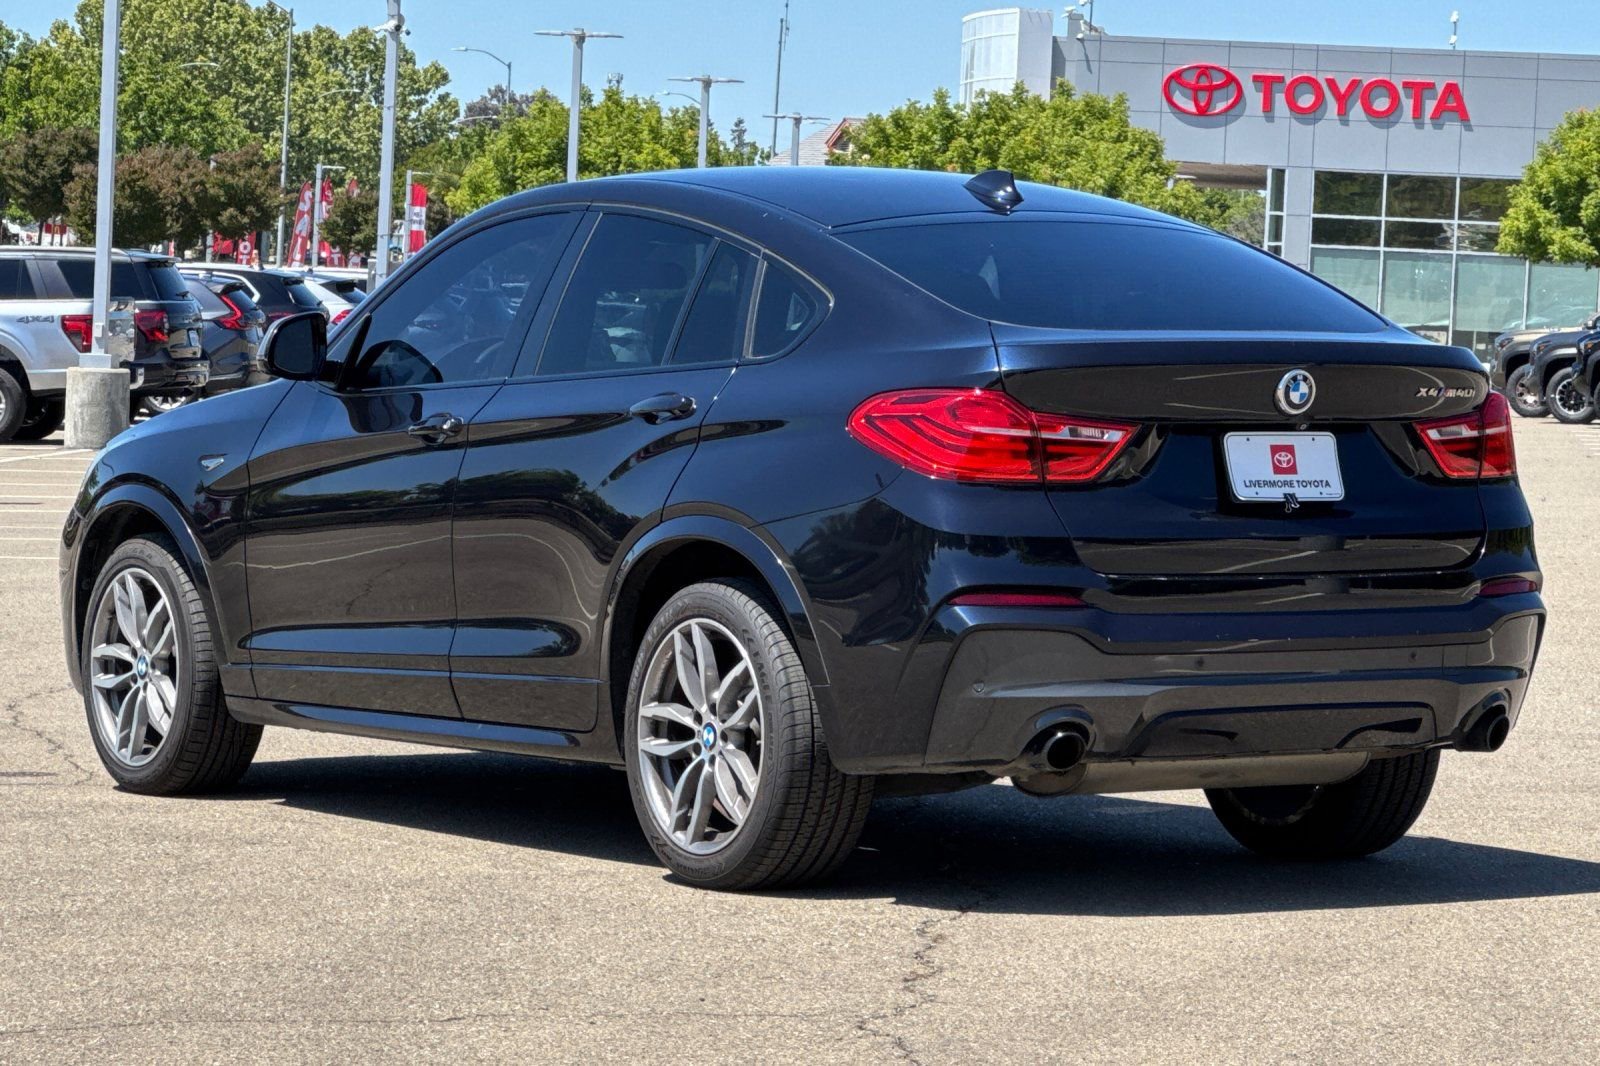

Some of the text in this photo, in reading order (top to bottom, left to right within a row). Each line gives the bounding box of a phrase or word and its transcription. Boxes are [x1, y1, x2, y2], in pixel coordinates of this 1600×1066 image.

[1252, 73, 1470, 122] TOYOTA
[1243, 479, 1331, 489] LIVERMORE TOYOTA
